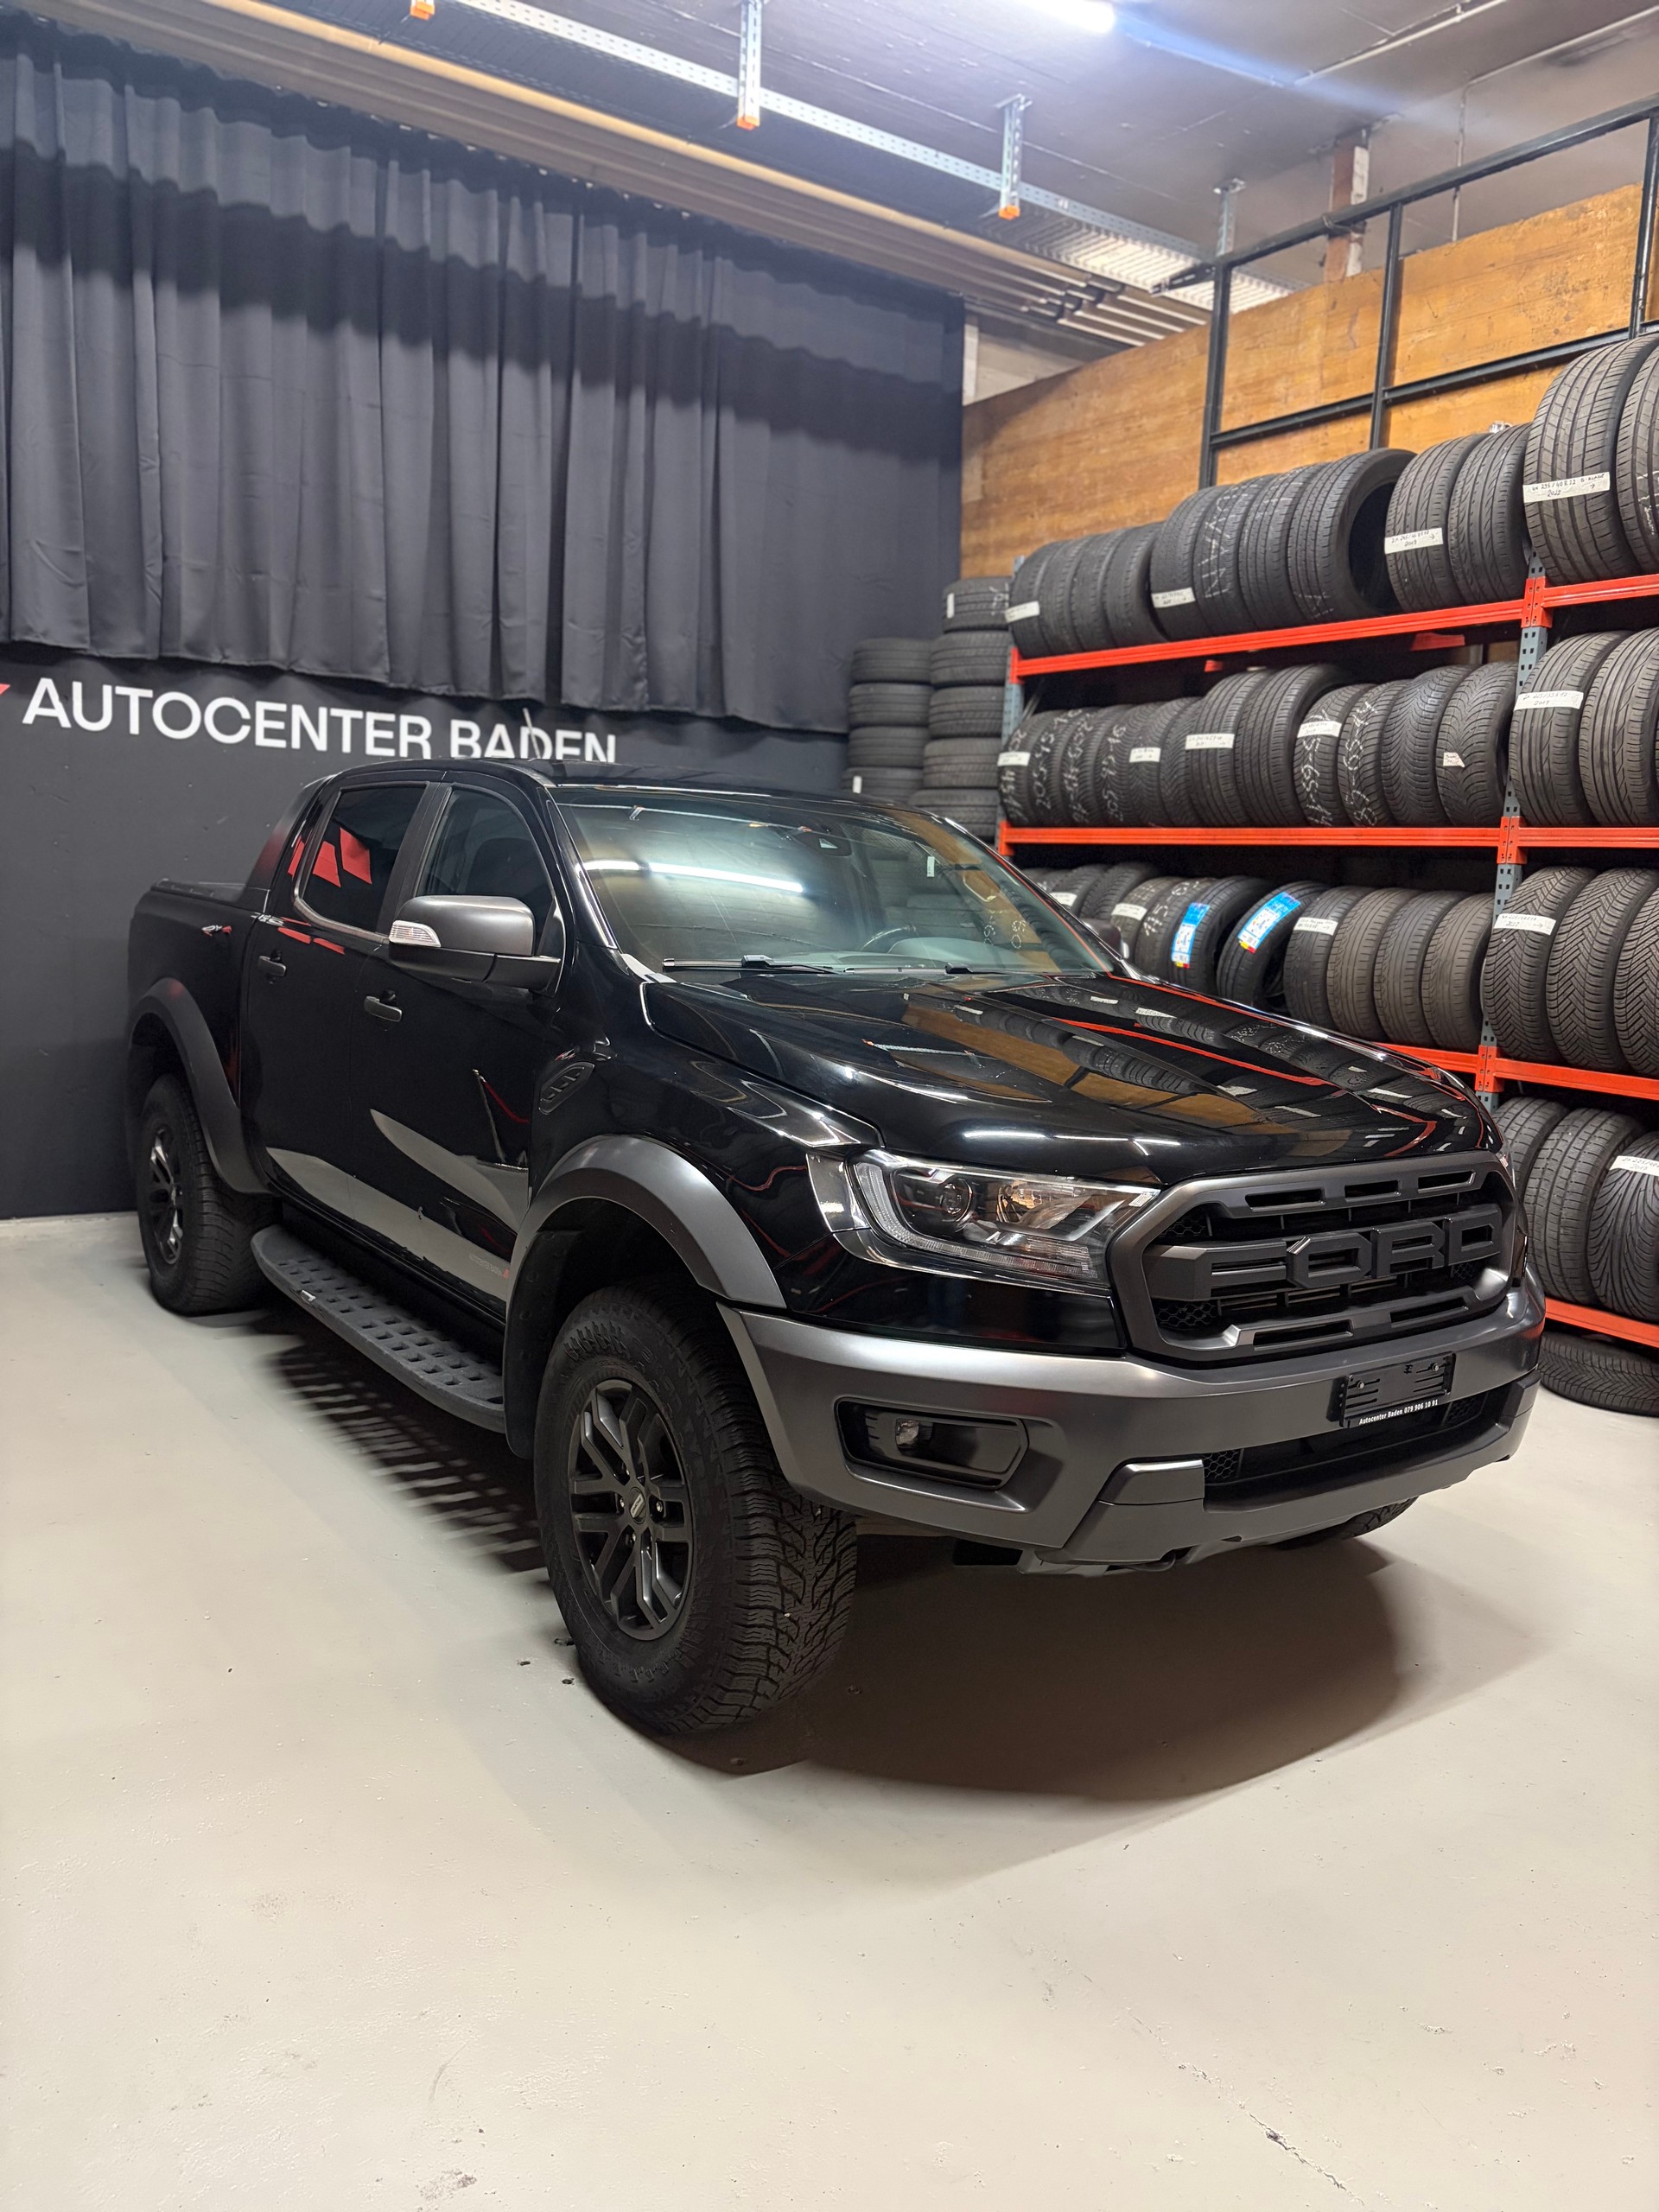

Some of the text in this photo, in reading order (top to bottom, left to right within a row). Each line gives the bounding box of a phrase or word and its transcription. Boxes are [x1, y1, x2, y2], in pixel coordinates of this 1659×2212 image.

[22, 677, 616, 764] AUTOCENTER BADEN
[1143, 1205, 1503, 1301] FORD
[1359, 1414, 1387, 1424] Autocenter
[1388, 1409, 1403, 1418] Baden
[1414, 1402, 1424, 1411] 906
